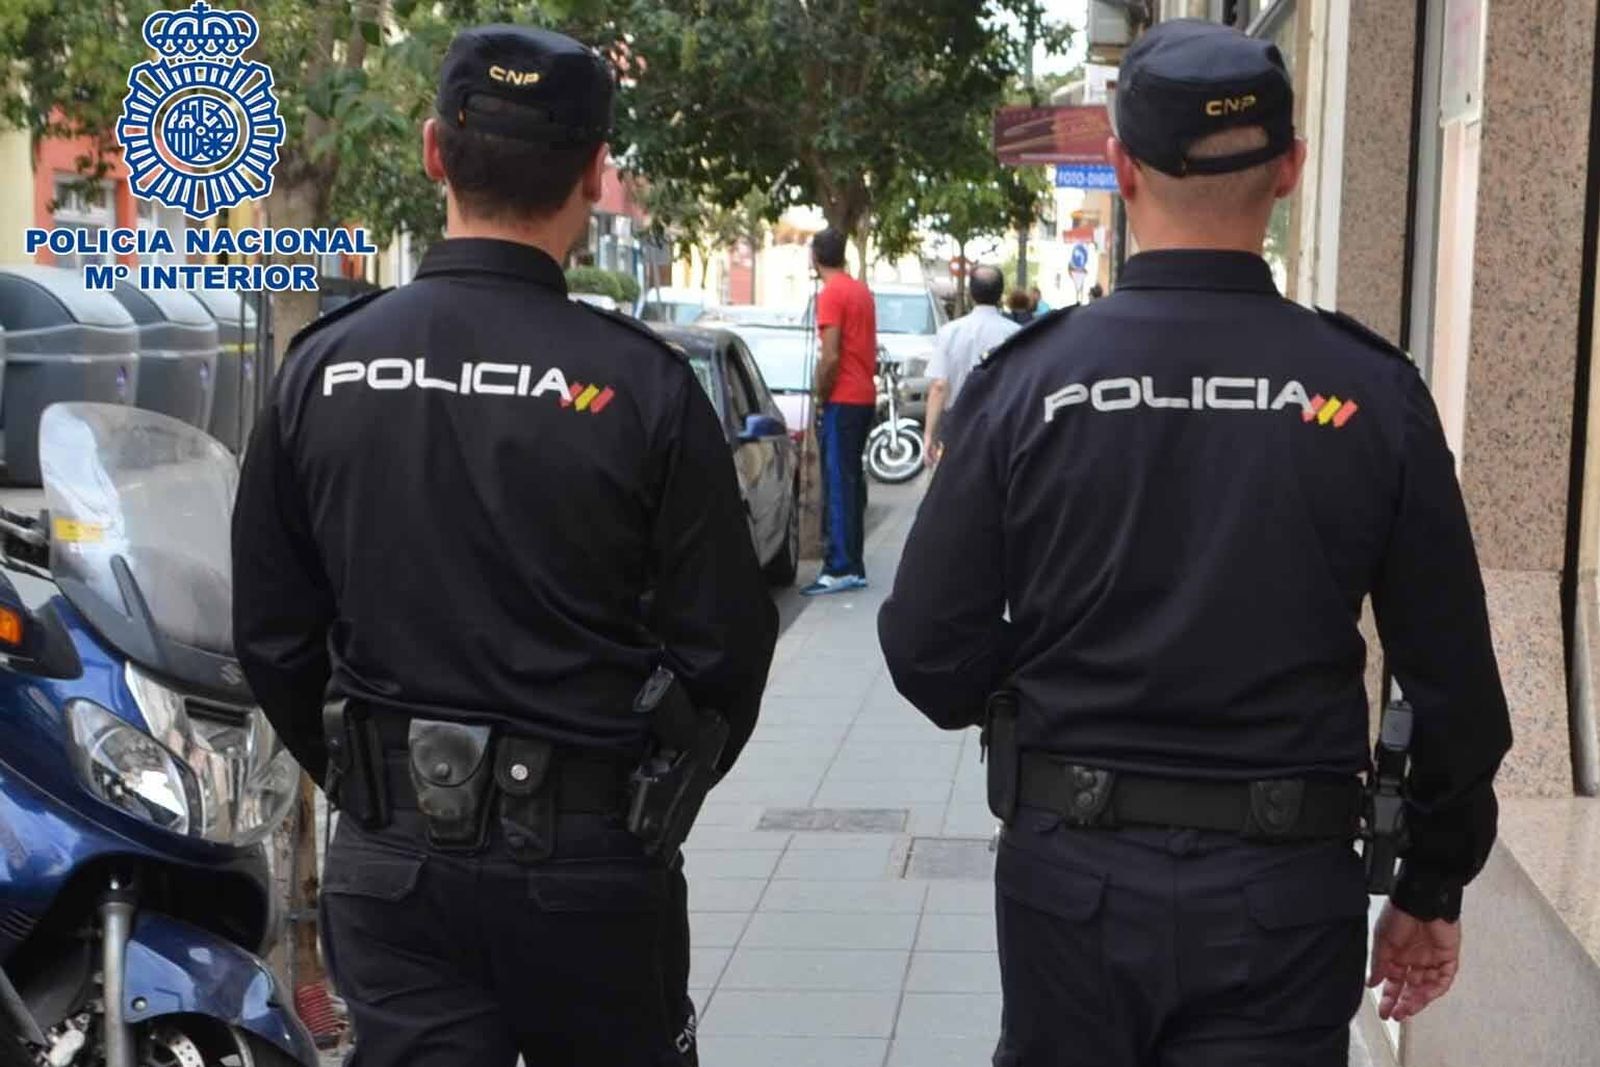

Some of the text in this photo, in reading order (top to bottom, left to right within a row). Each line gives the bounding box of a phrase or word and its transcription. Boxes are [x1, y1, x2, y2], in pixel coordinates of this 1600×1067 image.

[489, 65, 540, 85] CNP
[1206, 95, 1256, 115] CNP
[322, 358, 573, 402] POLICIA
[1044, 376, 1315, 423] POLICIA
